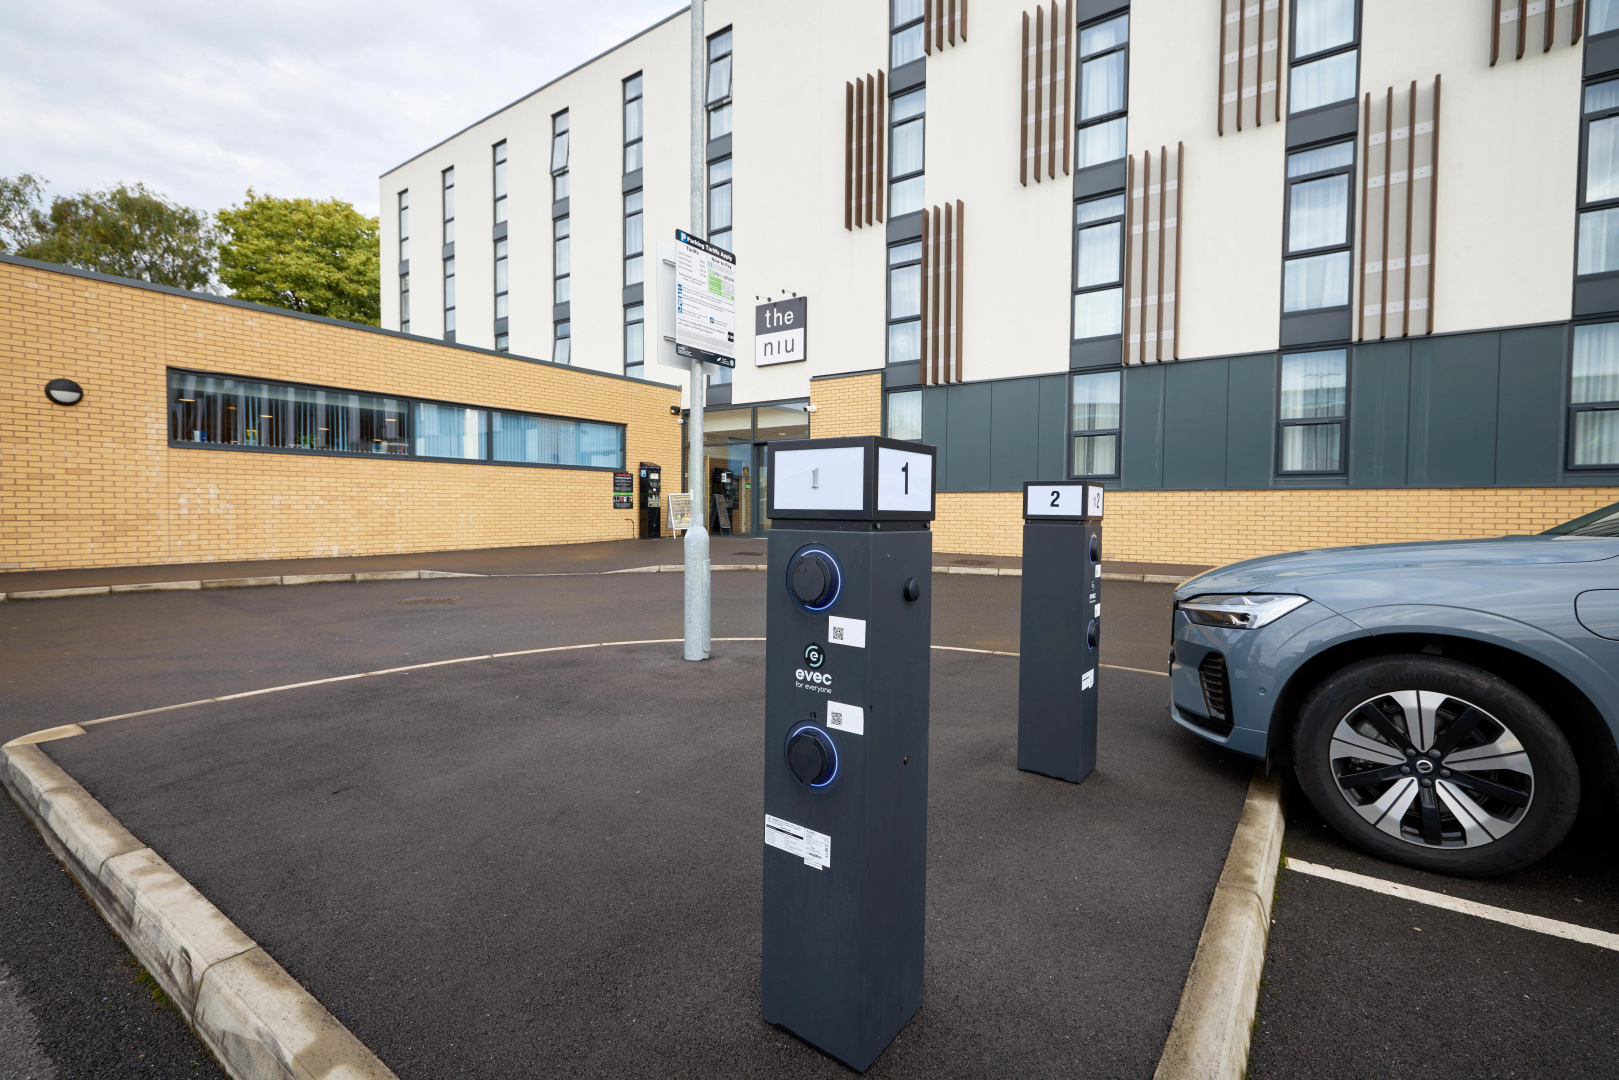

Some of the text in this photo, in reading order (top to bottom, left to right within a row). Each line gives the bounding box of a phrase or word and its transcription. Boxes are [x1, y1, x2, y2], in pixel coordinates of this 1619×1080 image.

[686, 245, 699, 255] Tariffs
[687, 236, 705, 250] Parking
[706, 244, 720, 256] Tariffs
[720, 251, 733, 262] Apply
[765, 307, 794, 328] the
[764, 338, 795, 357] niu
[811, 466, 819, 489] 1
[901, 461, 909, 495] 1
[1050, 490, 1061, 508] 2
[795, 669, 832, 686] evec
[1366, 670, 1460, 689] Continental
[795, 681, 832, 694] for everyone
